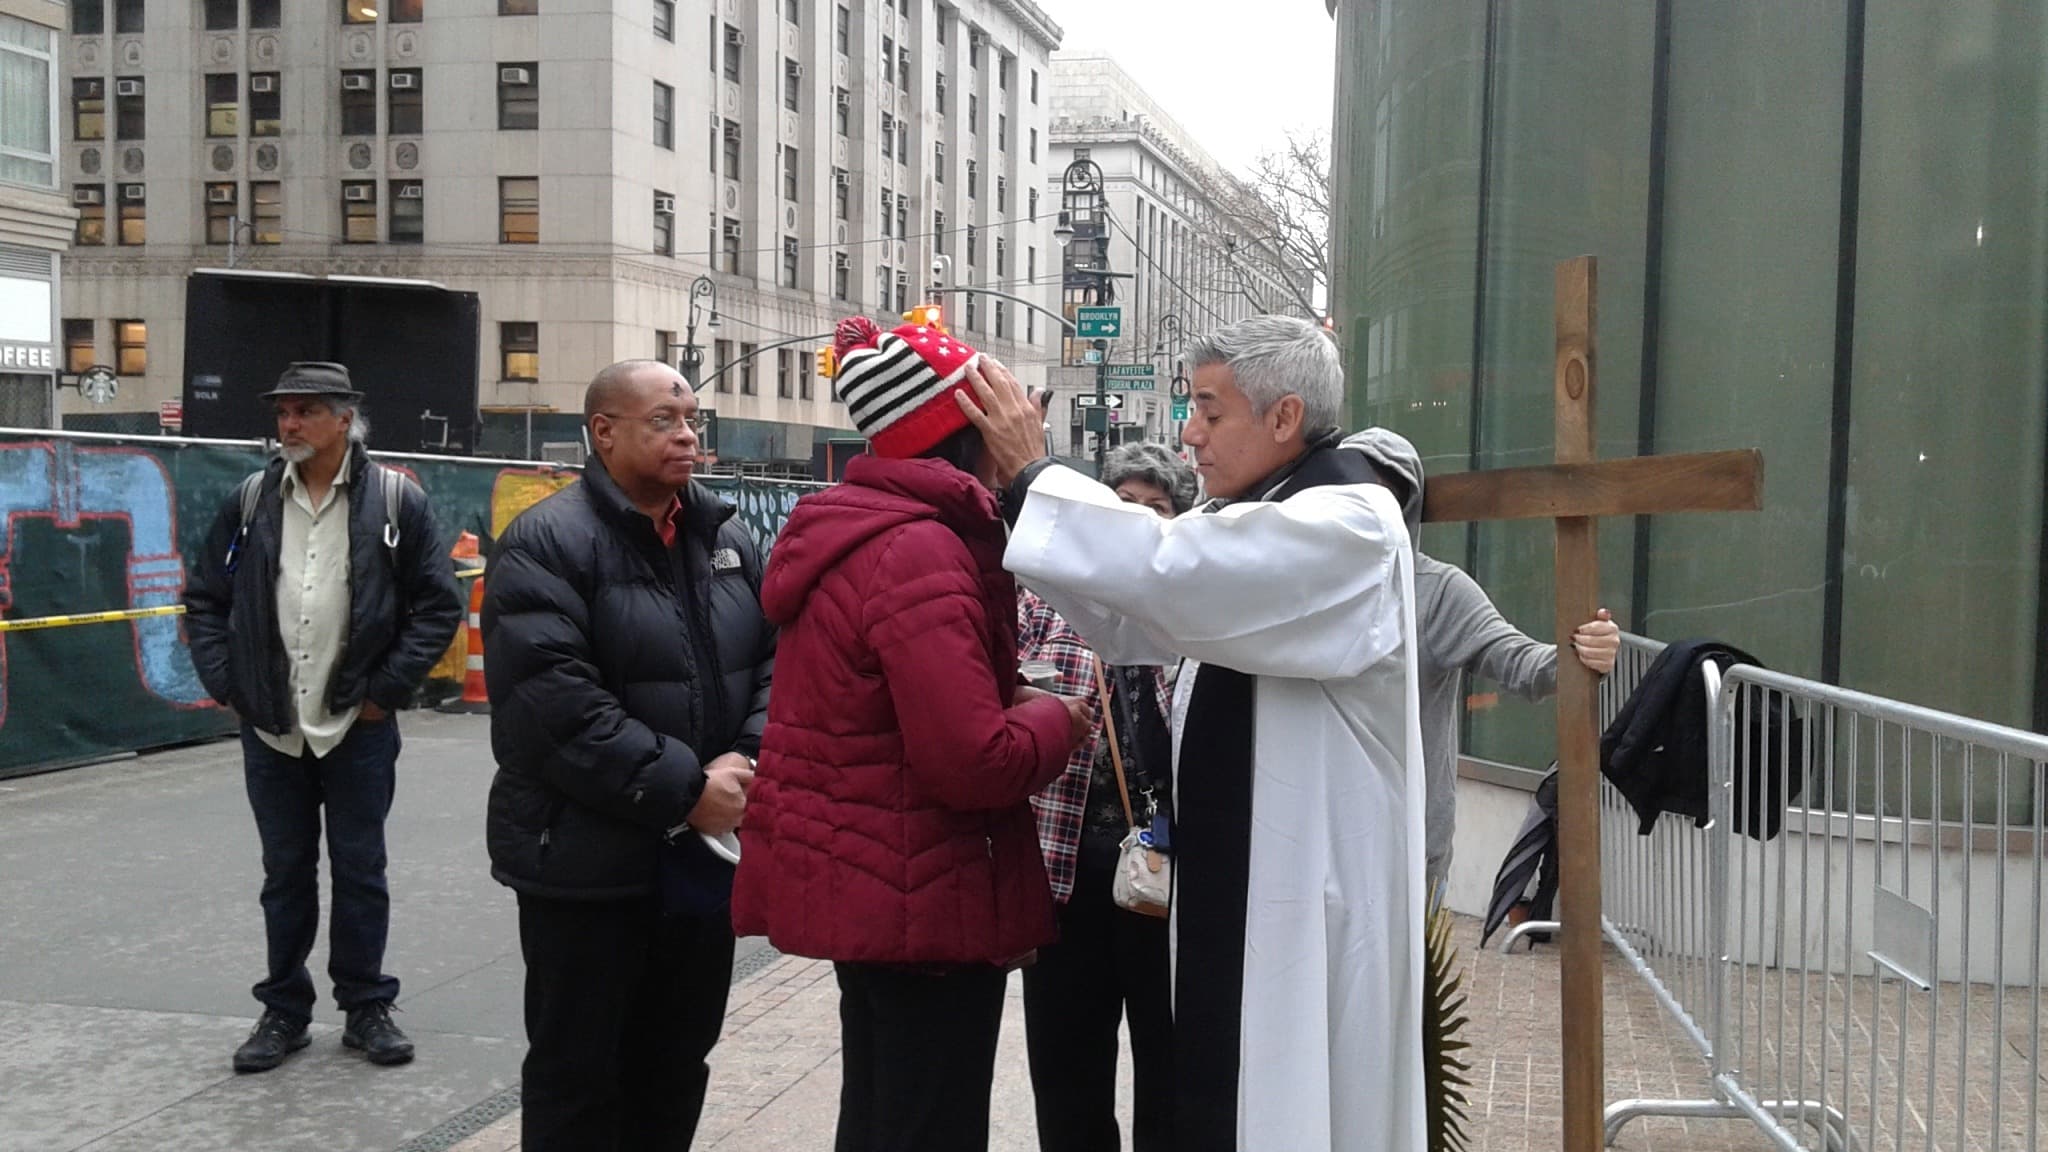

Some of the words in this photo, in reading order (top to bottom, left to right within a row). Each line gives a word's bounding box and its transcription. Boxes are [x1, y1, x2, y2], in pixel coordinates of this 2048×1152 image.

[1079, 311, 1119, 321] BROOKLYN
[0, 345, 52, 367] FFEE
[1108, 366, 1145, 376] LAFAYETTE
[1107, 380, 1131, 390] FEDERAL
[1133, 380, 1153, 390] PLAZA
